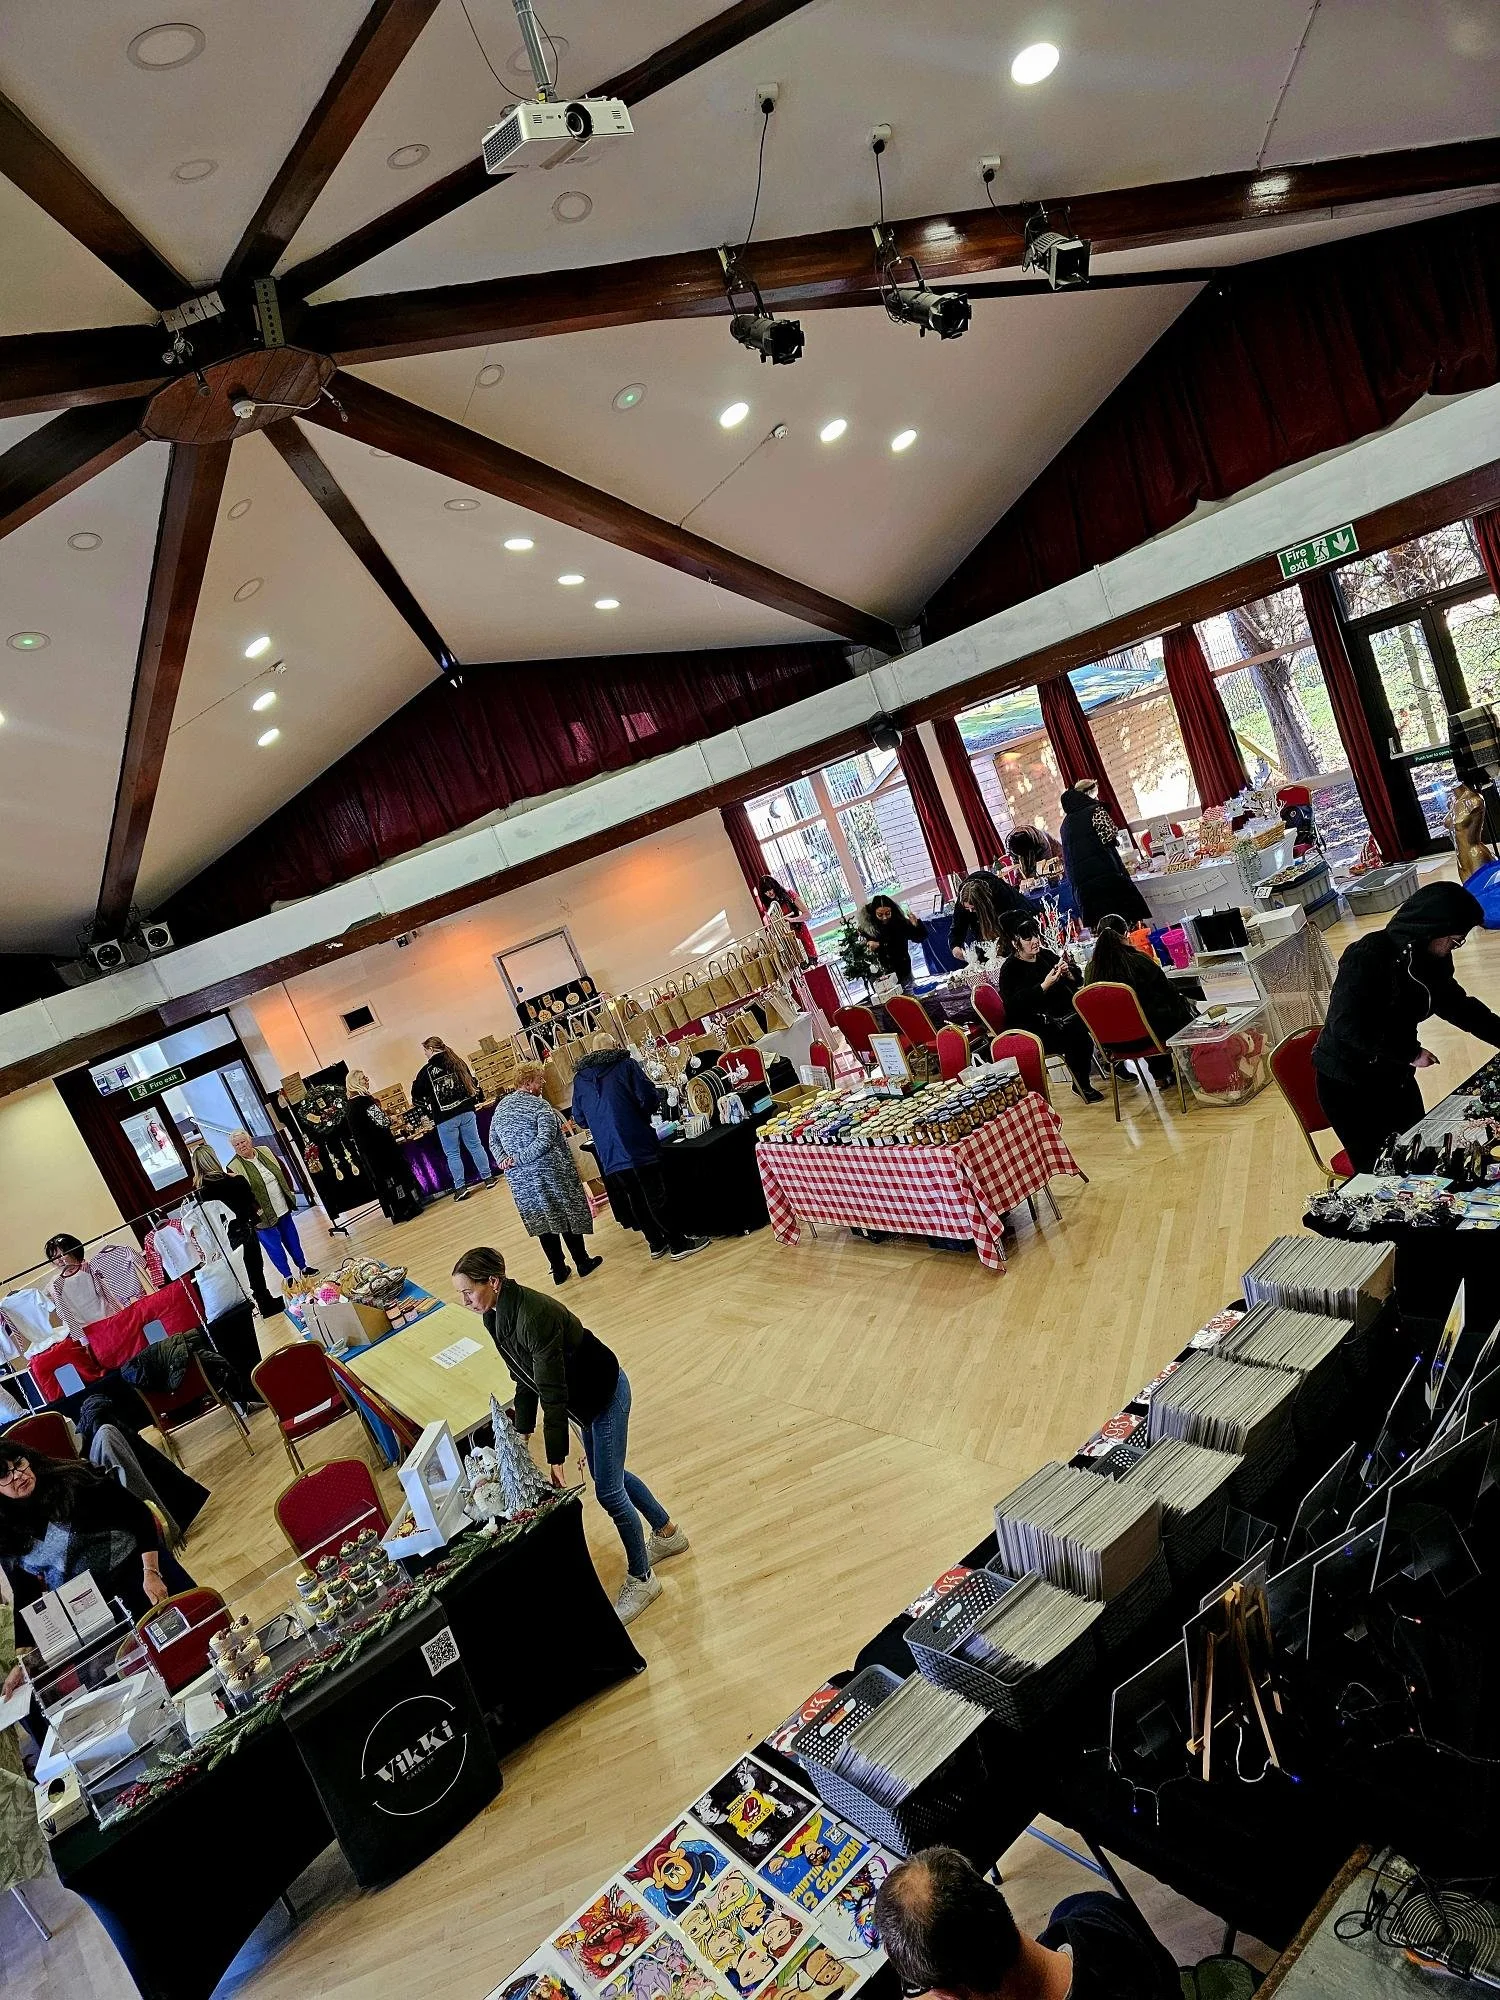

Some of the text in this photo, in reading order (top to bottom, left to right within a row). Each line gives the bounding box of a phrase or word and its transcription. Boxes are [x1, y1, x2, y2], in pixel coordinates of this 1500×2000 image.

[1285, 548, 1307, 563] Fire
[1289, 558, 1310, 573] exit
[149, 1074, 178, 1090] Fire exit
[1104, 1420, 1129, 1438] £6
[743, 1807, 771, 1833] Stones
[802, 1837, 863, 1909] HEROES &
[788, 1865, 825, 1903] VILLAINS
